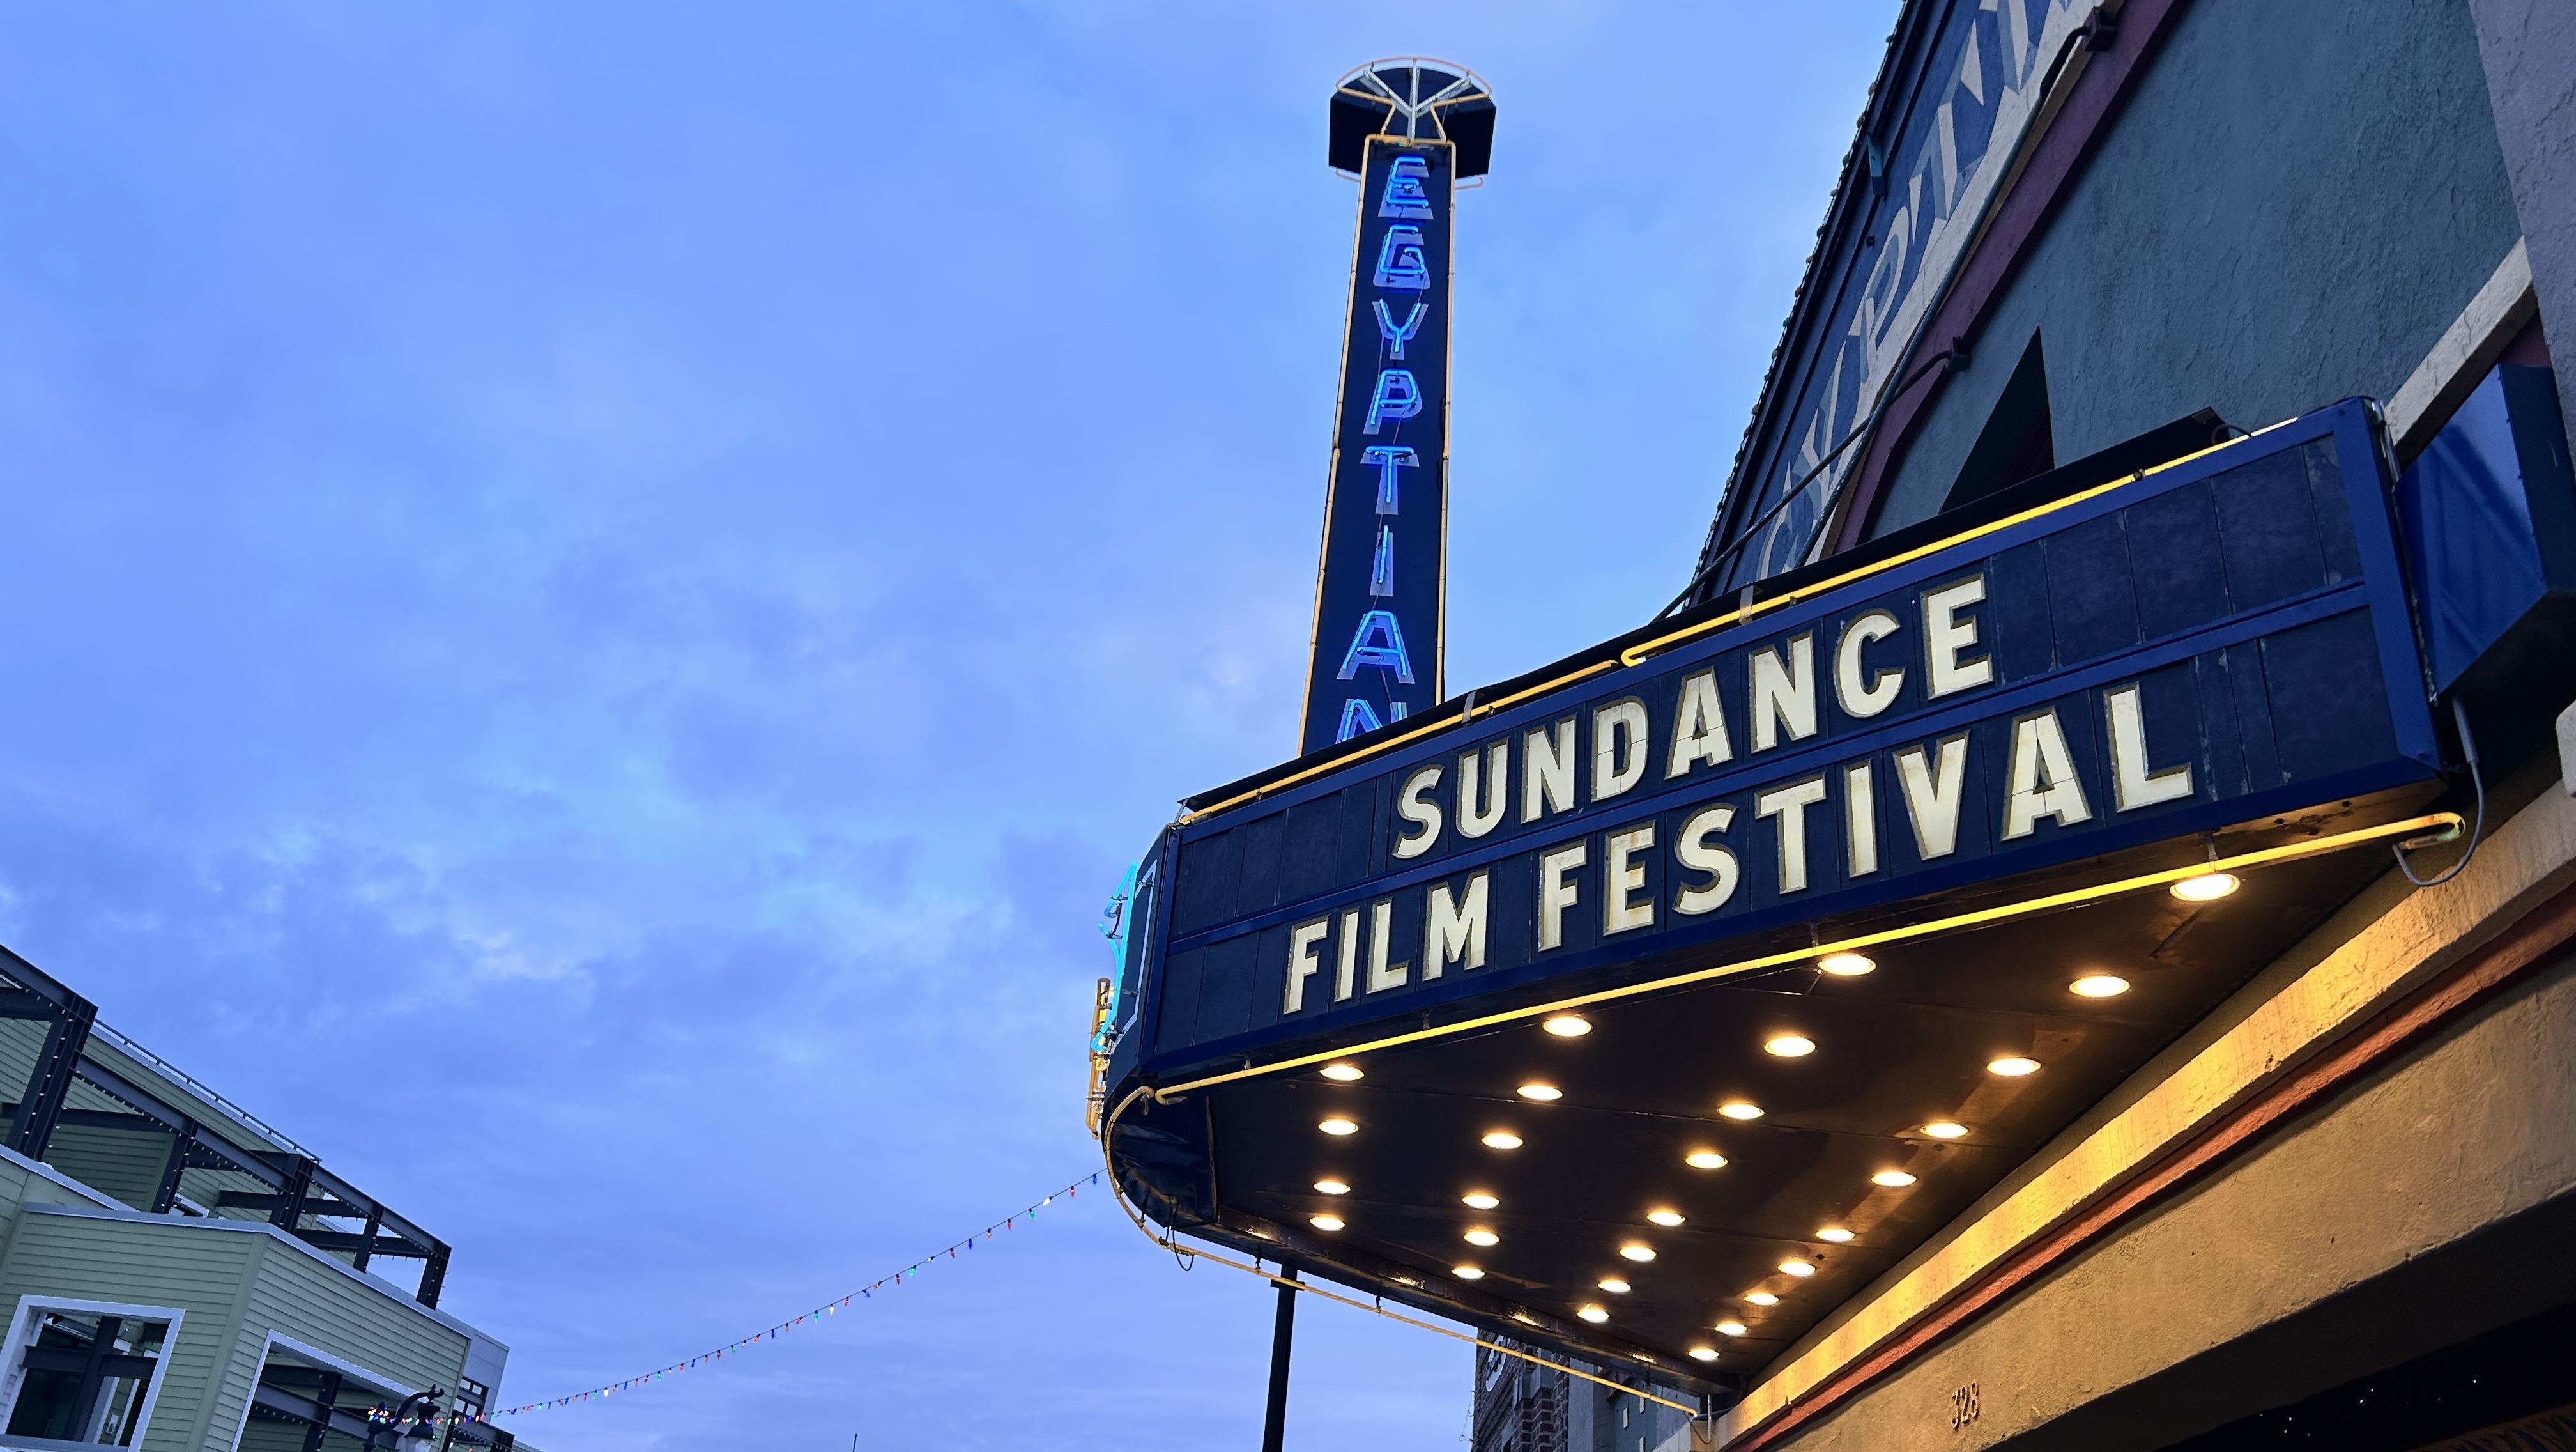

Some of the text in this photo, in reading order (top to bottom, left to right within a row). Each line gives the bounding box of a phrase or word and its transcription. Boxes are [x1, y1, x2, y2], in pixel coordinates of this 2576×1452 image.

[1282, 685, 2193, 1016] FILM FESTIVAL
[1393, 575, 1994, 860] SUNDANCE
[1952, 1382, 1979, 1429] 328
